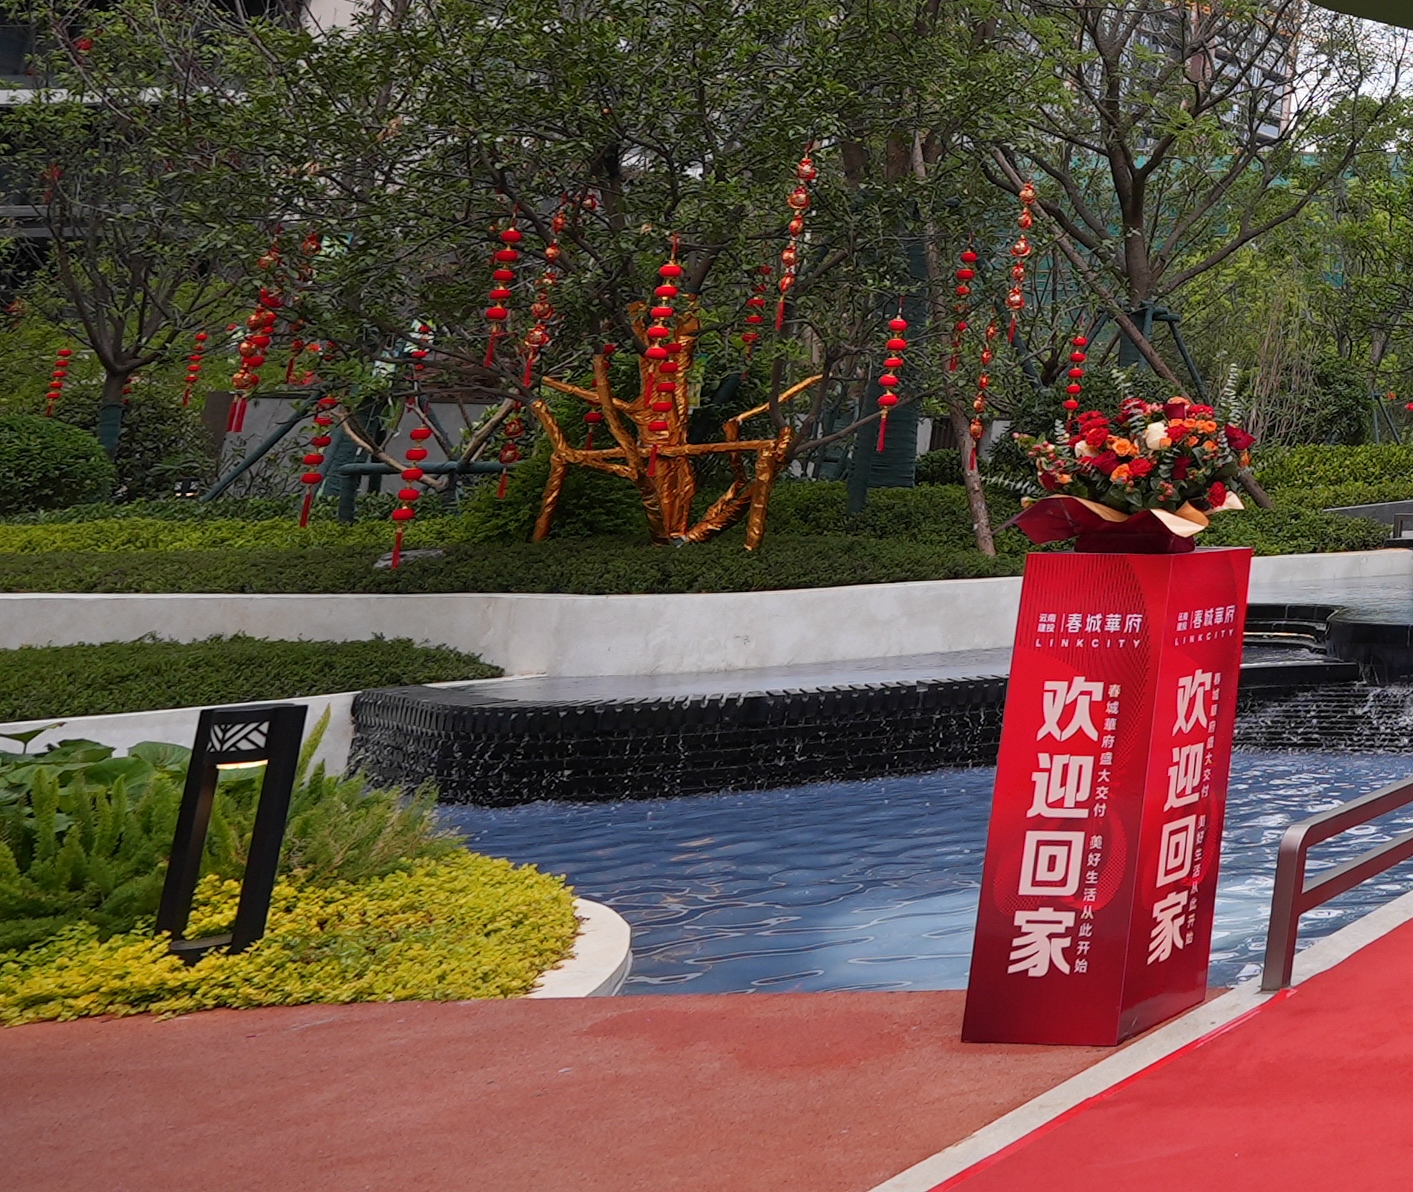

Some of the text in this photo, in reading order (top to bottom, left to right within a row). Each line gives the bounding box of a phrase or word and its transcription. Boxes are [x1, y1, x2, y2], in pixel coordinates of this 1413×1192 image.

[1035, 638, 1141, 649] LINKCITY
[1007, 676, 1104, 977] 欢迎回家
[1147, 670, 1213, 965] 欢迎回家
